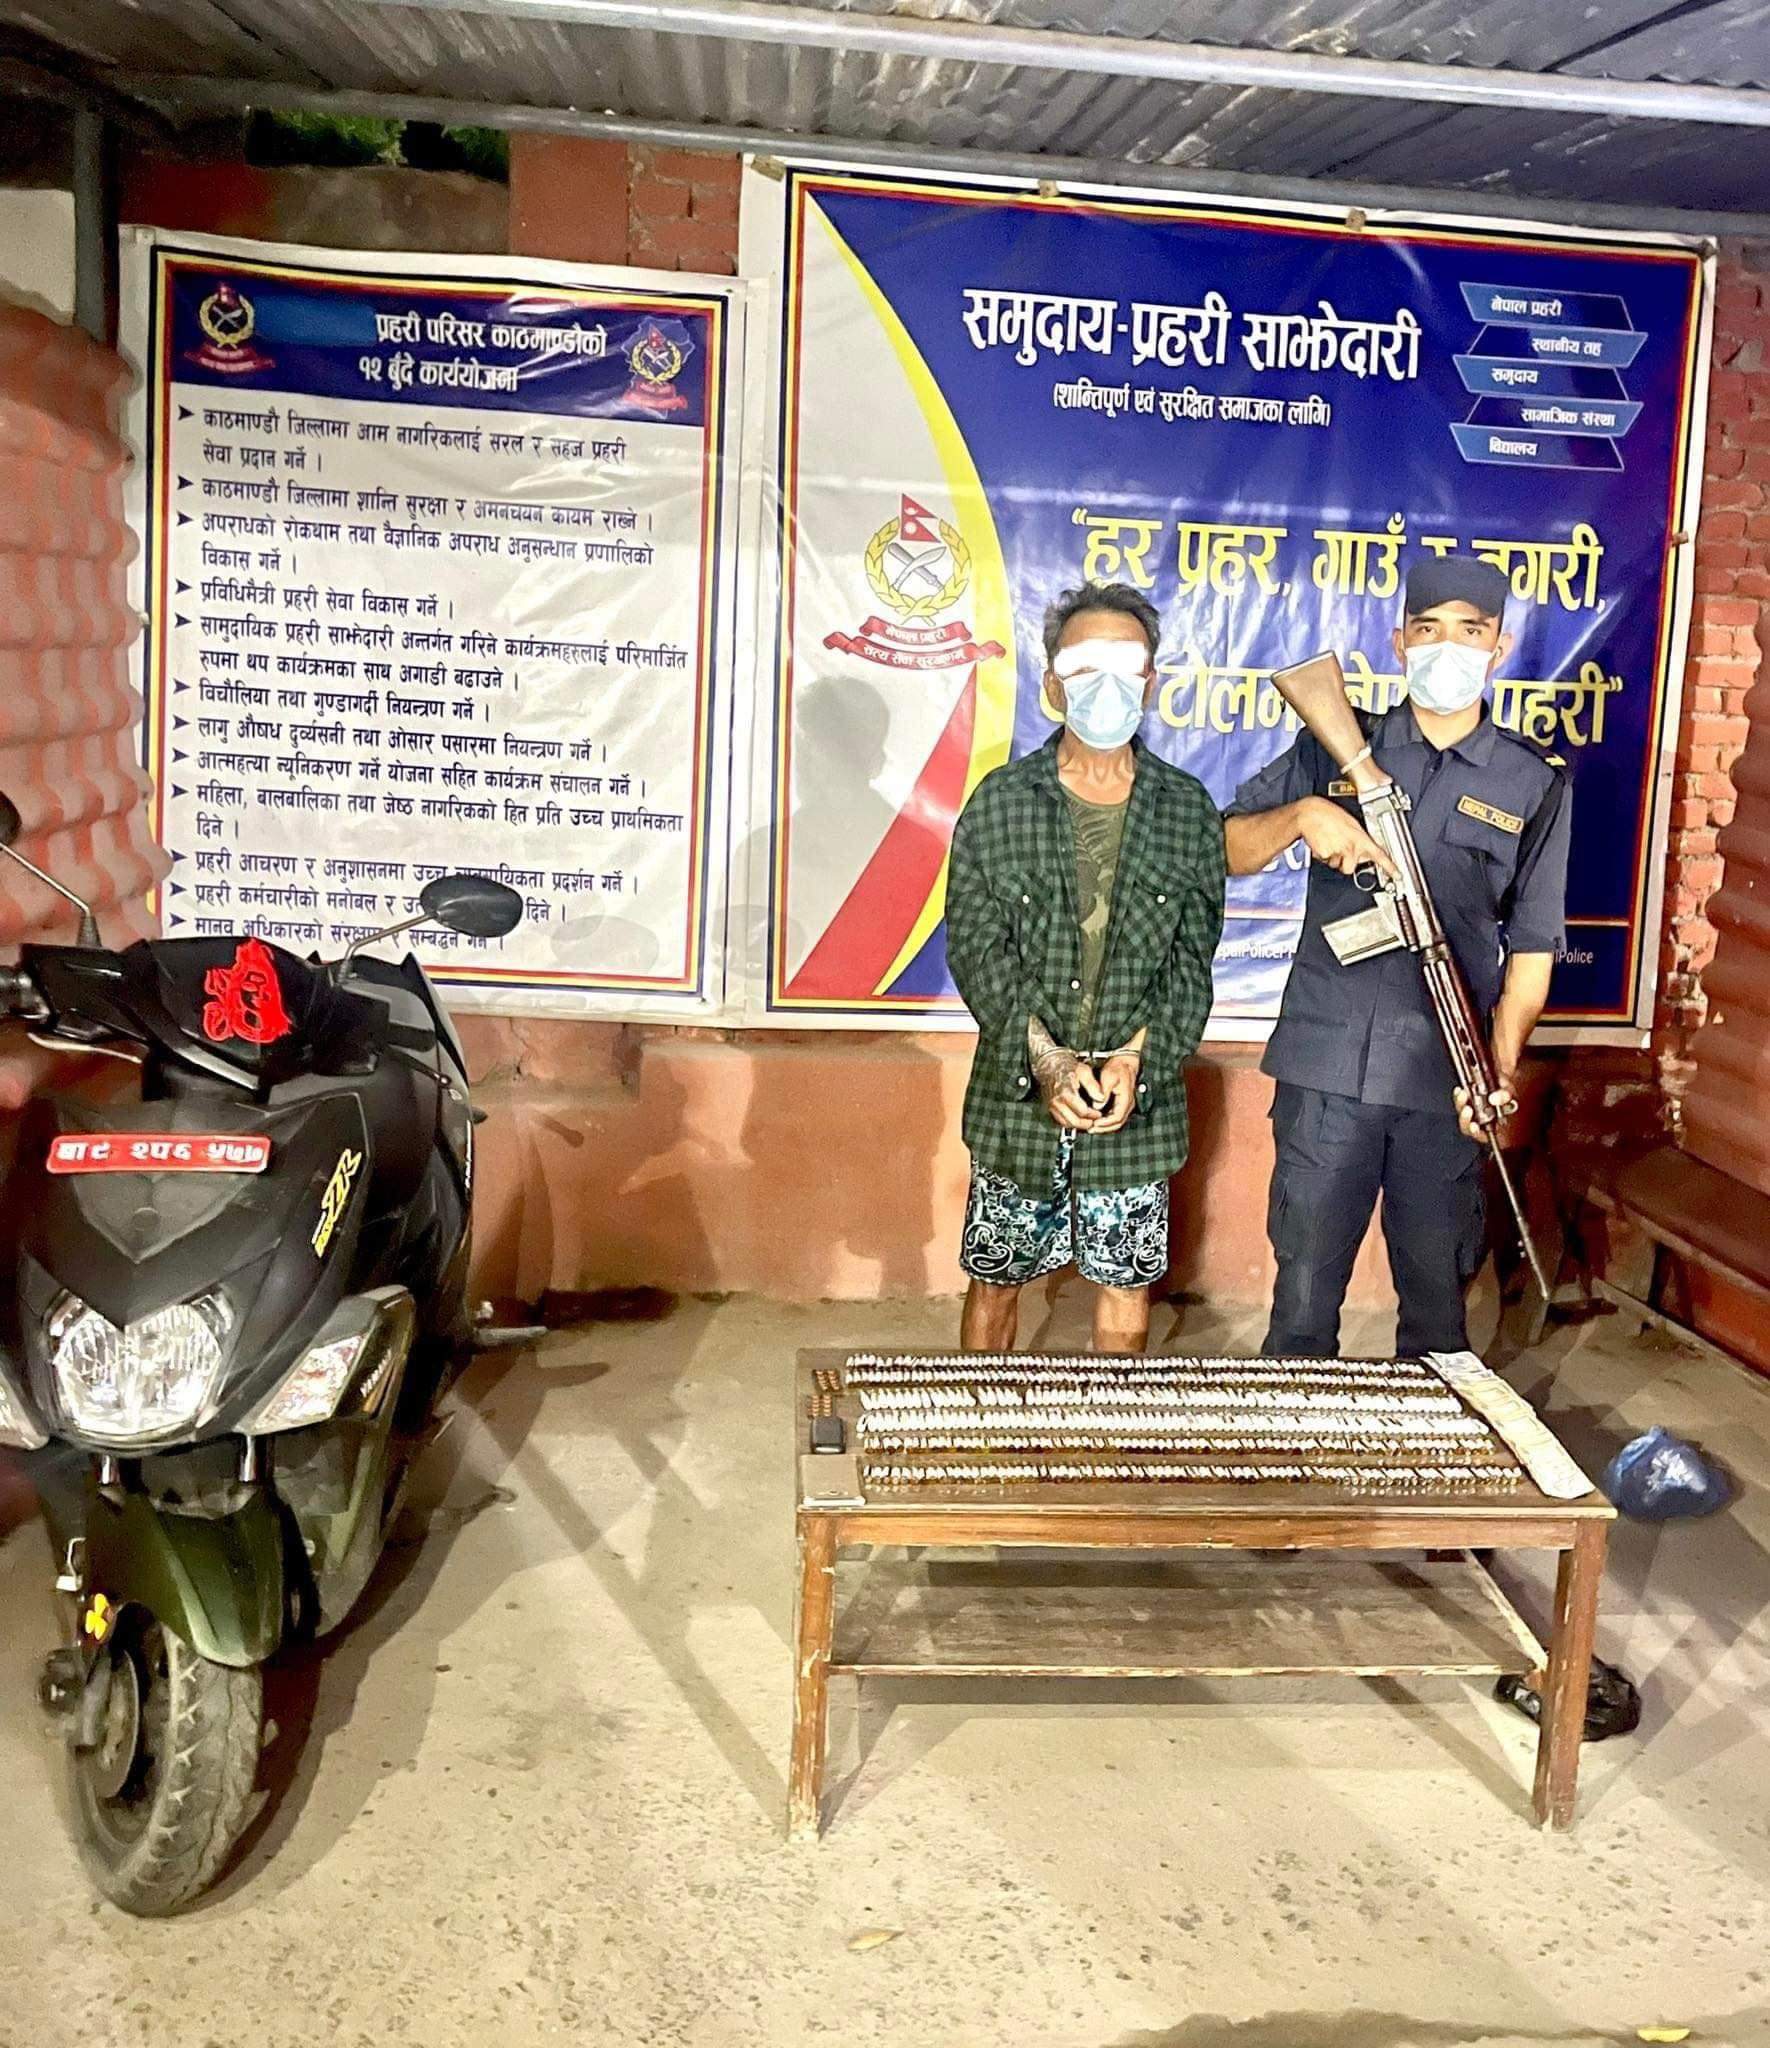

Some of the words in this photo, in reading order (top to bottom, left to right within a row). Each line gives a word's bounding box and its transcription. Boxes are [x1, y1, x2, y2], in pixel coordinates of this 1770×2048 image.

[375, 311, 421, 342] प्रहरी
[427, 312, 486, 347] परिसर
[961, 289, 1231, 367] समुदाय-प्रहरी
[1241, 300, 1422, 381] साझेदारी
[359, 356, 382, 381] १२
[532, 436, 543, 457] र
[455, 499, 466, 520] र
[1312, 512, 1406, 598] गाउँ
[304, 858, 316, 878] र
[385, 895, 396, 915] र
